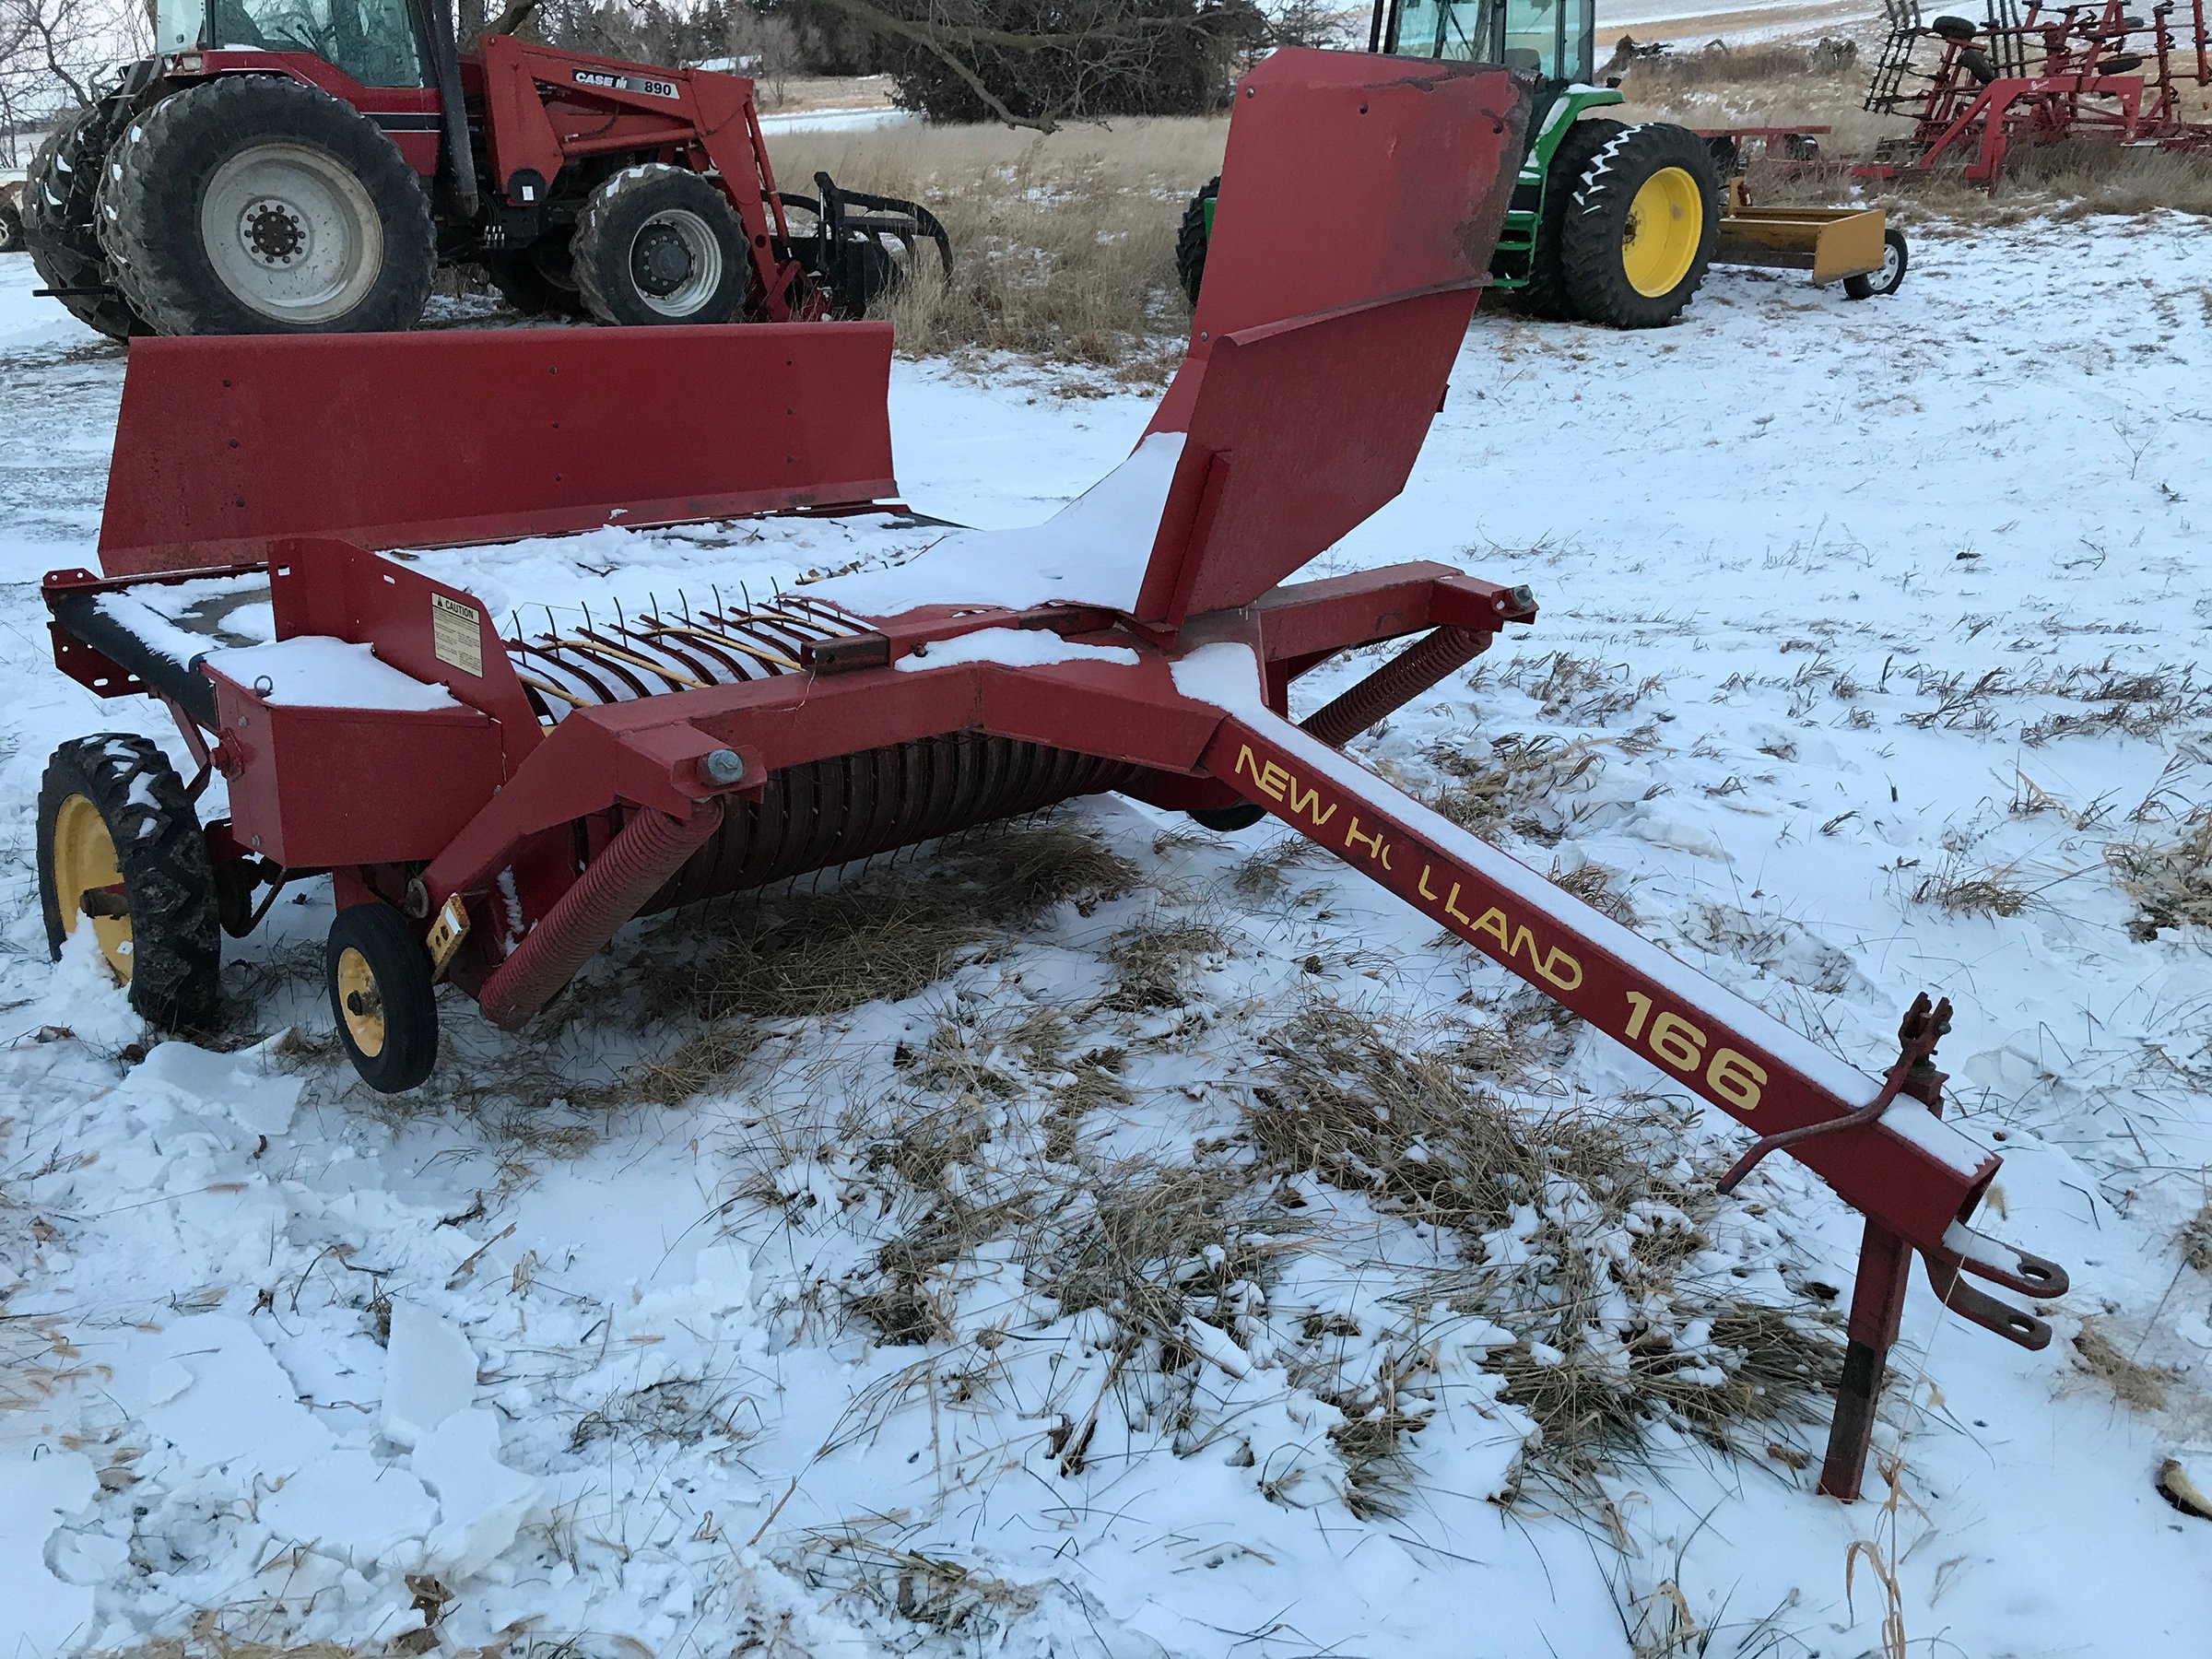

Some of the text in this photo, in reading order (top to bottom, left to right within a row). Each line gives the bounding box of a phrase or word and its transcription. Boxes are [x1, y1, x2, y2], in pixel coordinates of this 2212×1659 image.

[575, 72, 613, 87] CASE
[645, 81, 671, 96] 890
[445, 600, 474, 619] CAUTION
[1234, 743, 1338, 826] NEW
[1624, 990, 1769, 1111] 166
